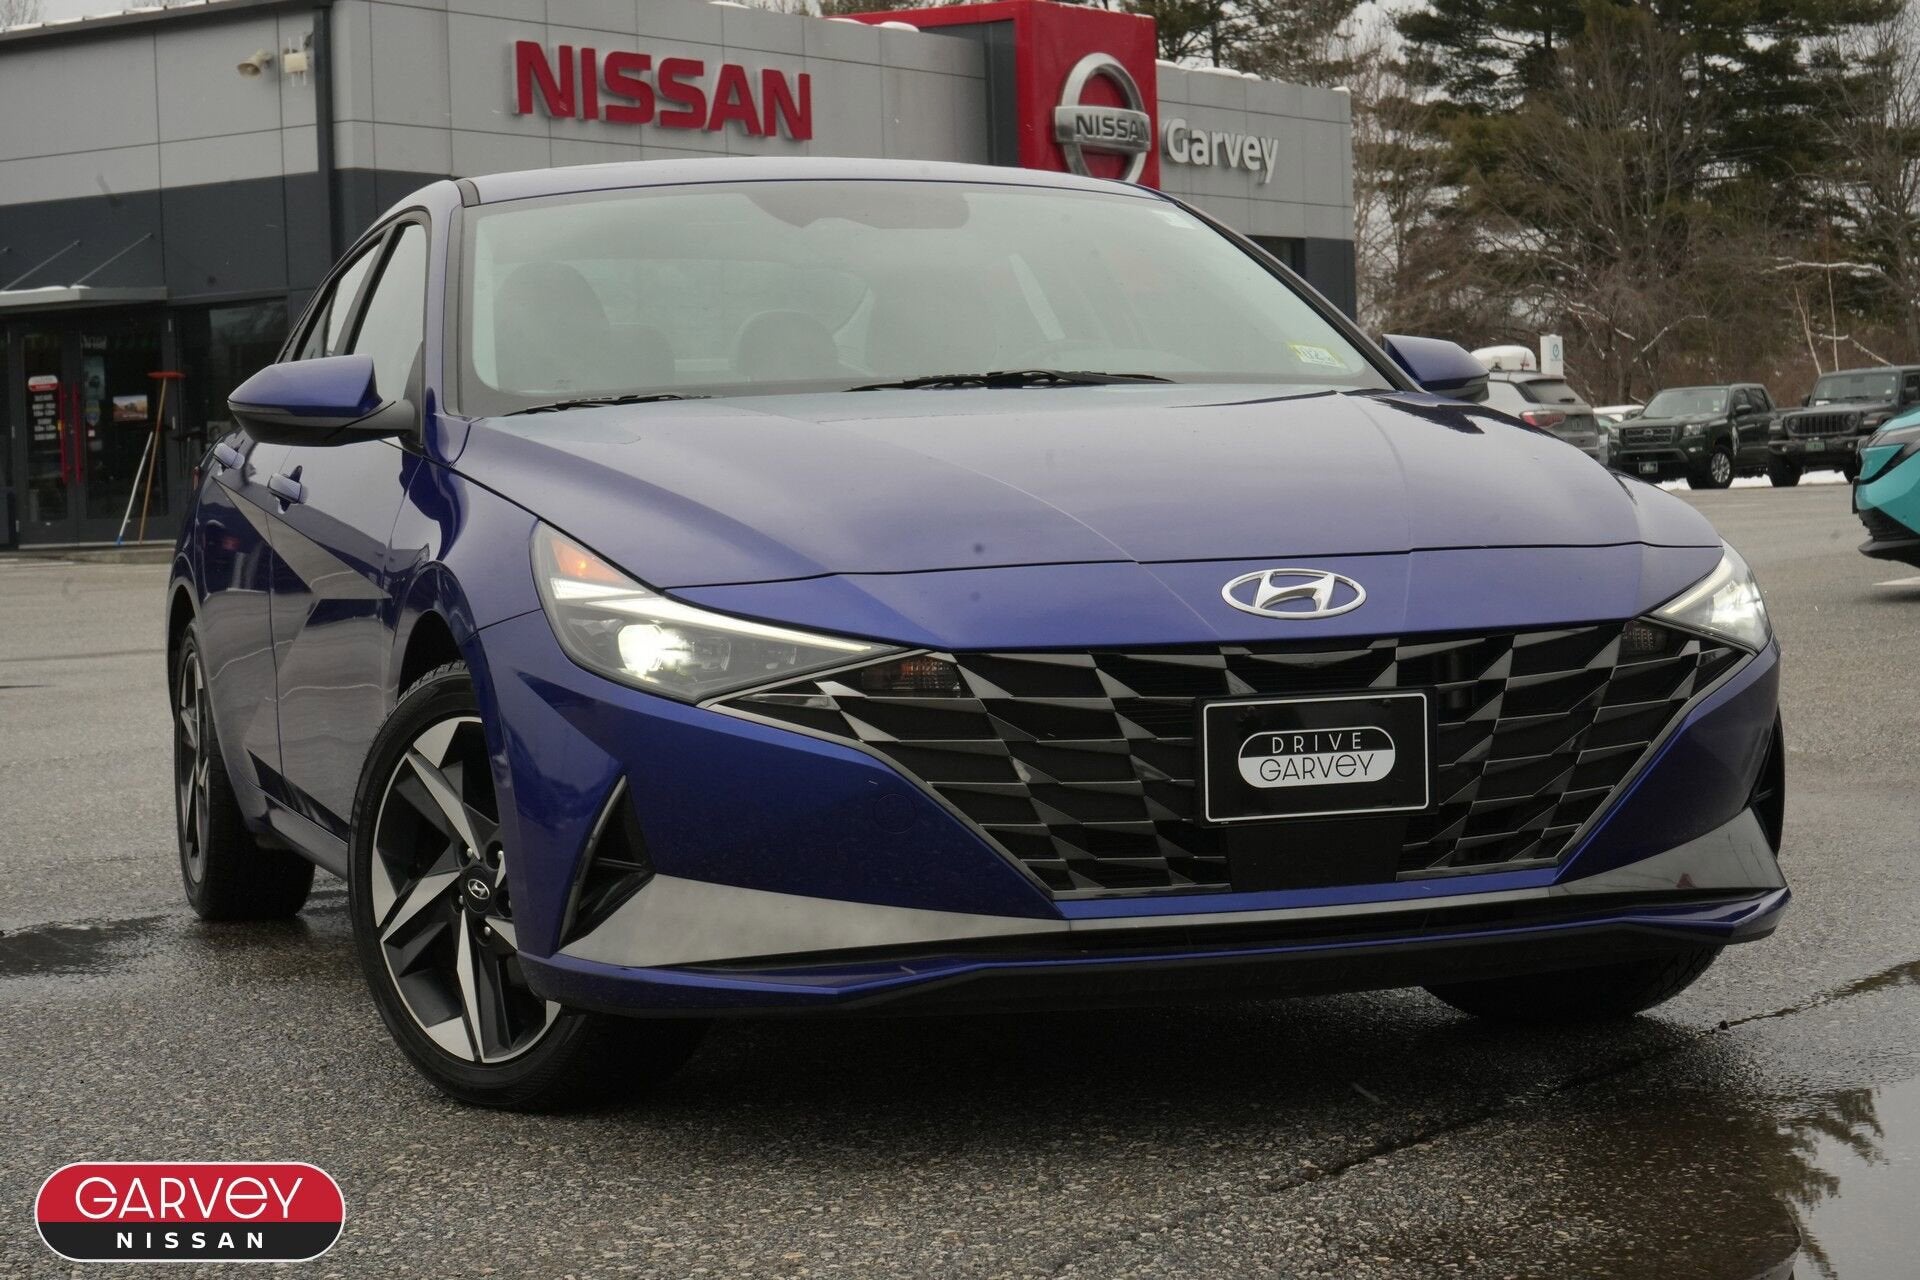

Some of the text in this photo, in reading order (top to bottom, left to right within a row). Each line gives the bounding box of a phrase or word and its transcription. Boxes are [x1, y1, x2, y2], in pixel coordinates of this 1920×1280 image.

[515, 40, 813, 141] NISSAN
[1165, 118, 1279, 184] Garvey
[1272, 732, 1362, 754] DRIVE
